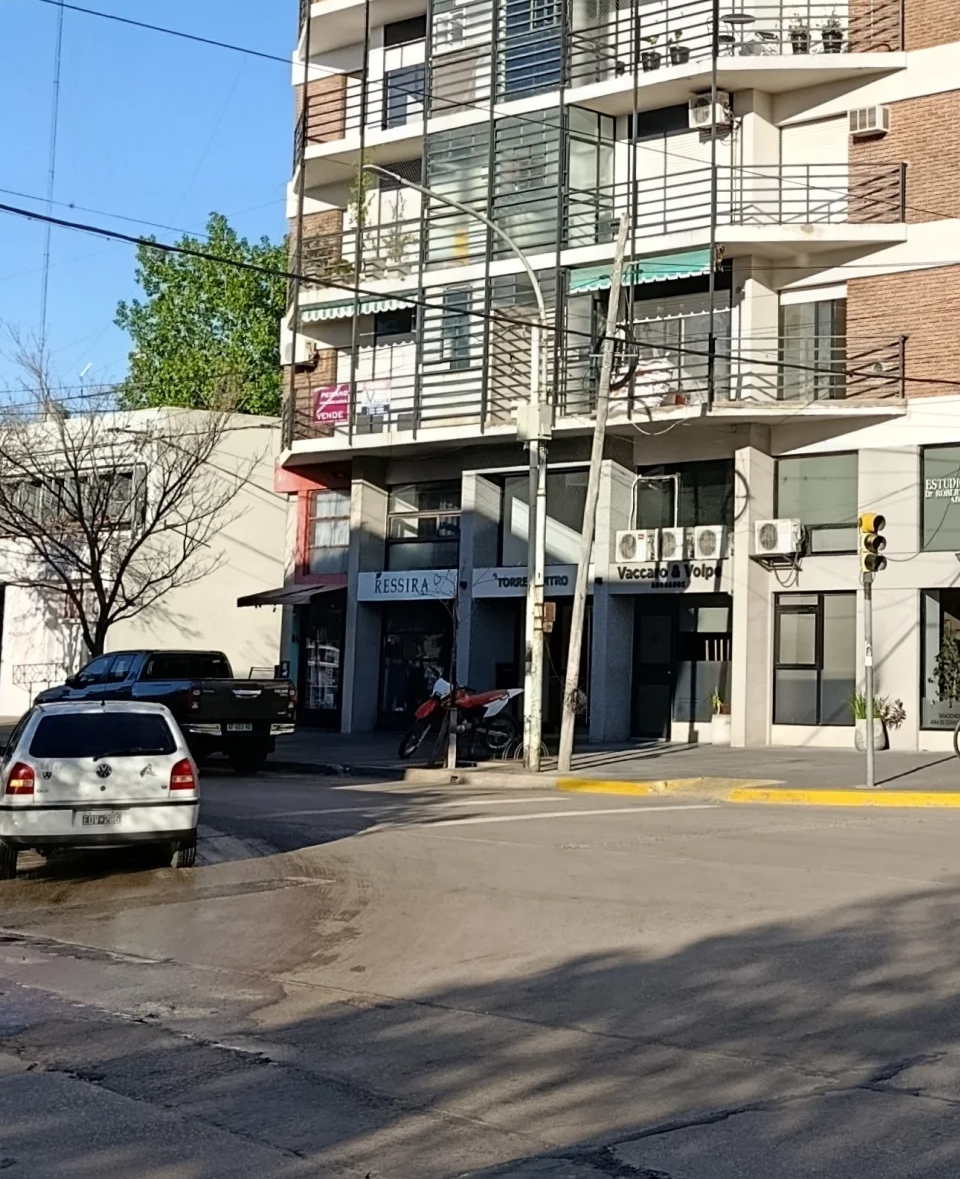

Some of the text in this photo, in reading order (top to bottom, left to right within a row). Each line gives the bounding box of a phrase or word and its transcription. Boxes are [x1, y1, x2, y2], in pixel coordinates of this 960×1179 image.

[316, 411, 344, 420] VENDE
[617, 564, 722, 580] Vaccaro & Volpe
[374, 577, 429, 594] RESSIRA
[497, 576, 528, 588] TORRE
